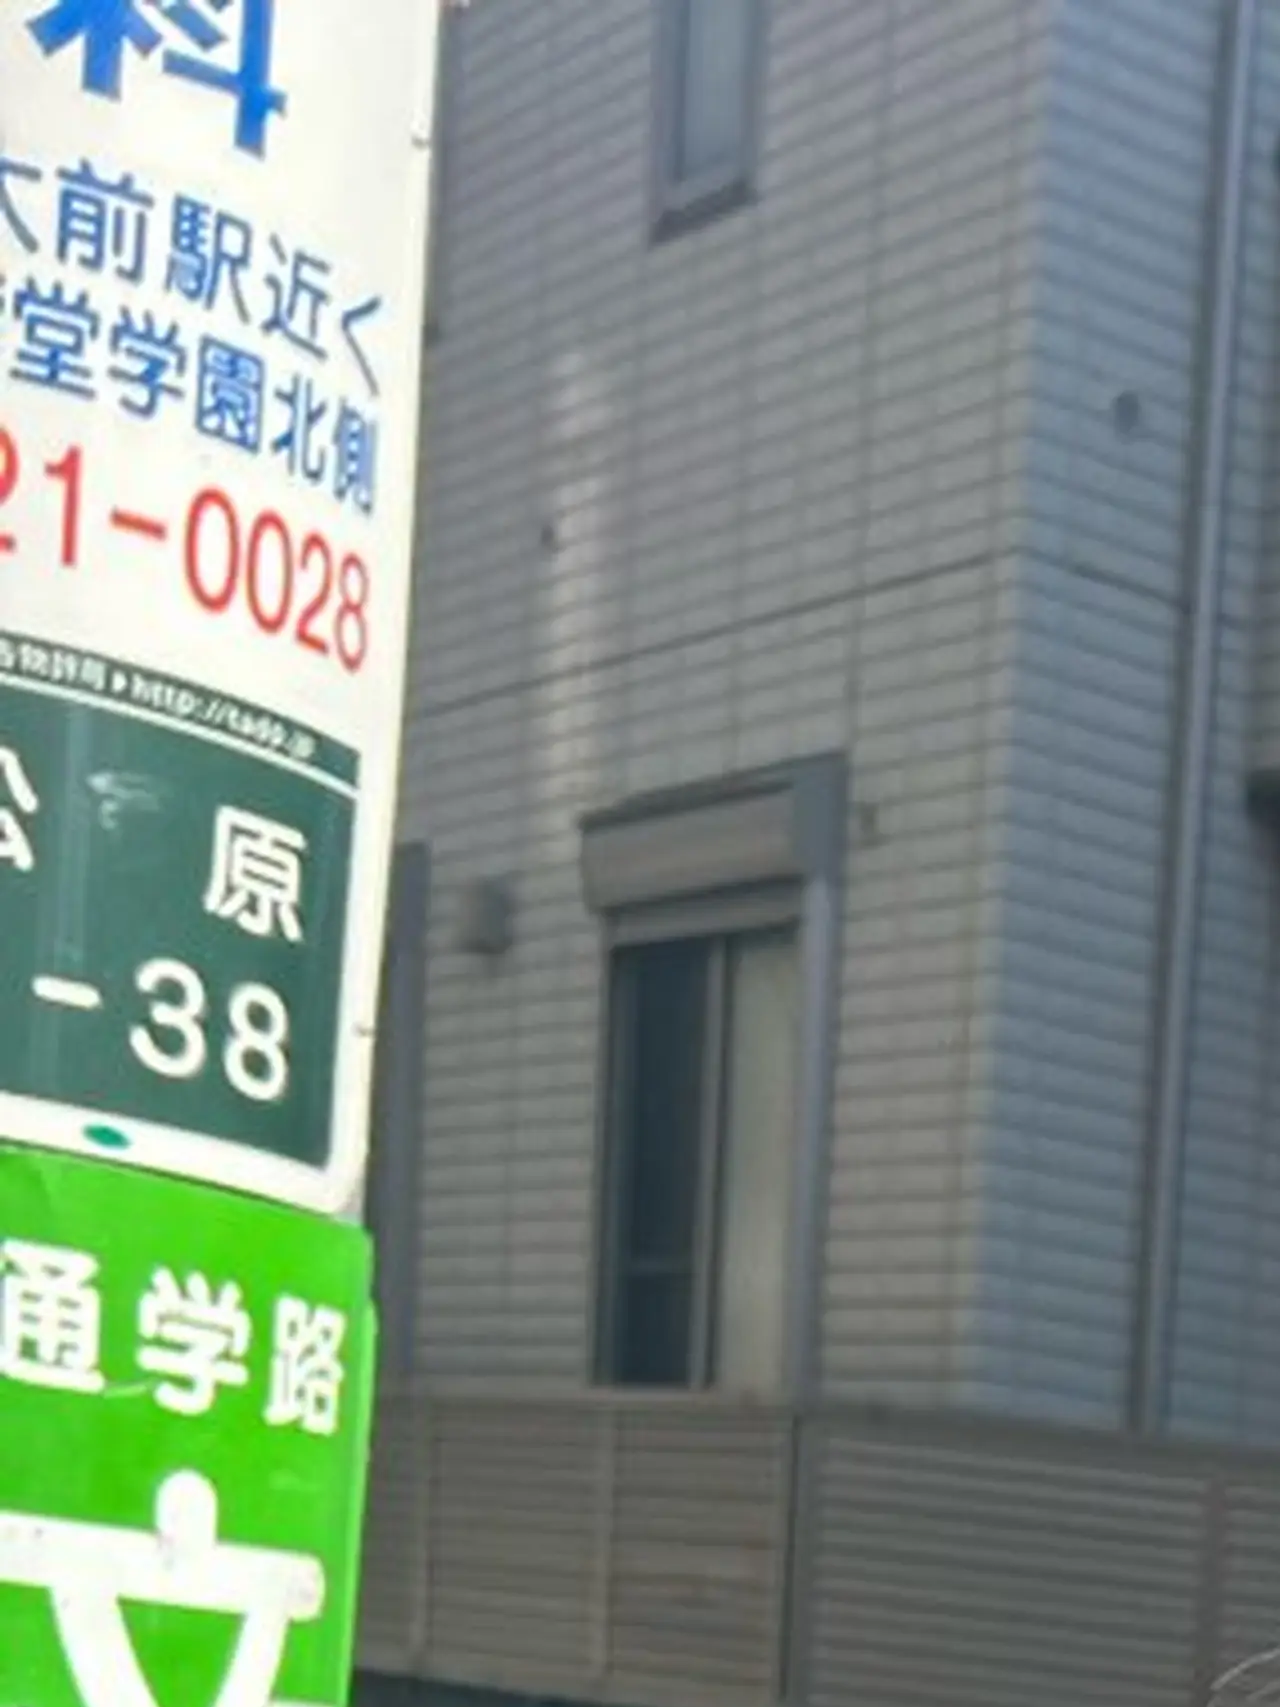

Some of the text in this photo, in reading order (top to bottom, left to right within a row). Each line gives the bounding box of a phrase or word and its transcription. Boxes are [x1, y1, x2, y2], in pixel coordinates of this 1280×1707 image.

[0, 274, 377, 514] 堂学園北側
[0, 1238, 347, 1436] 通学路
